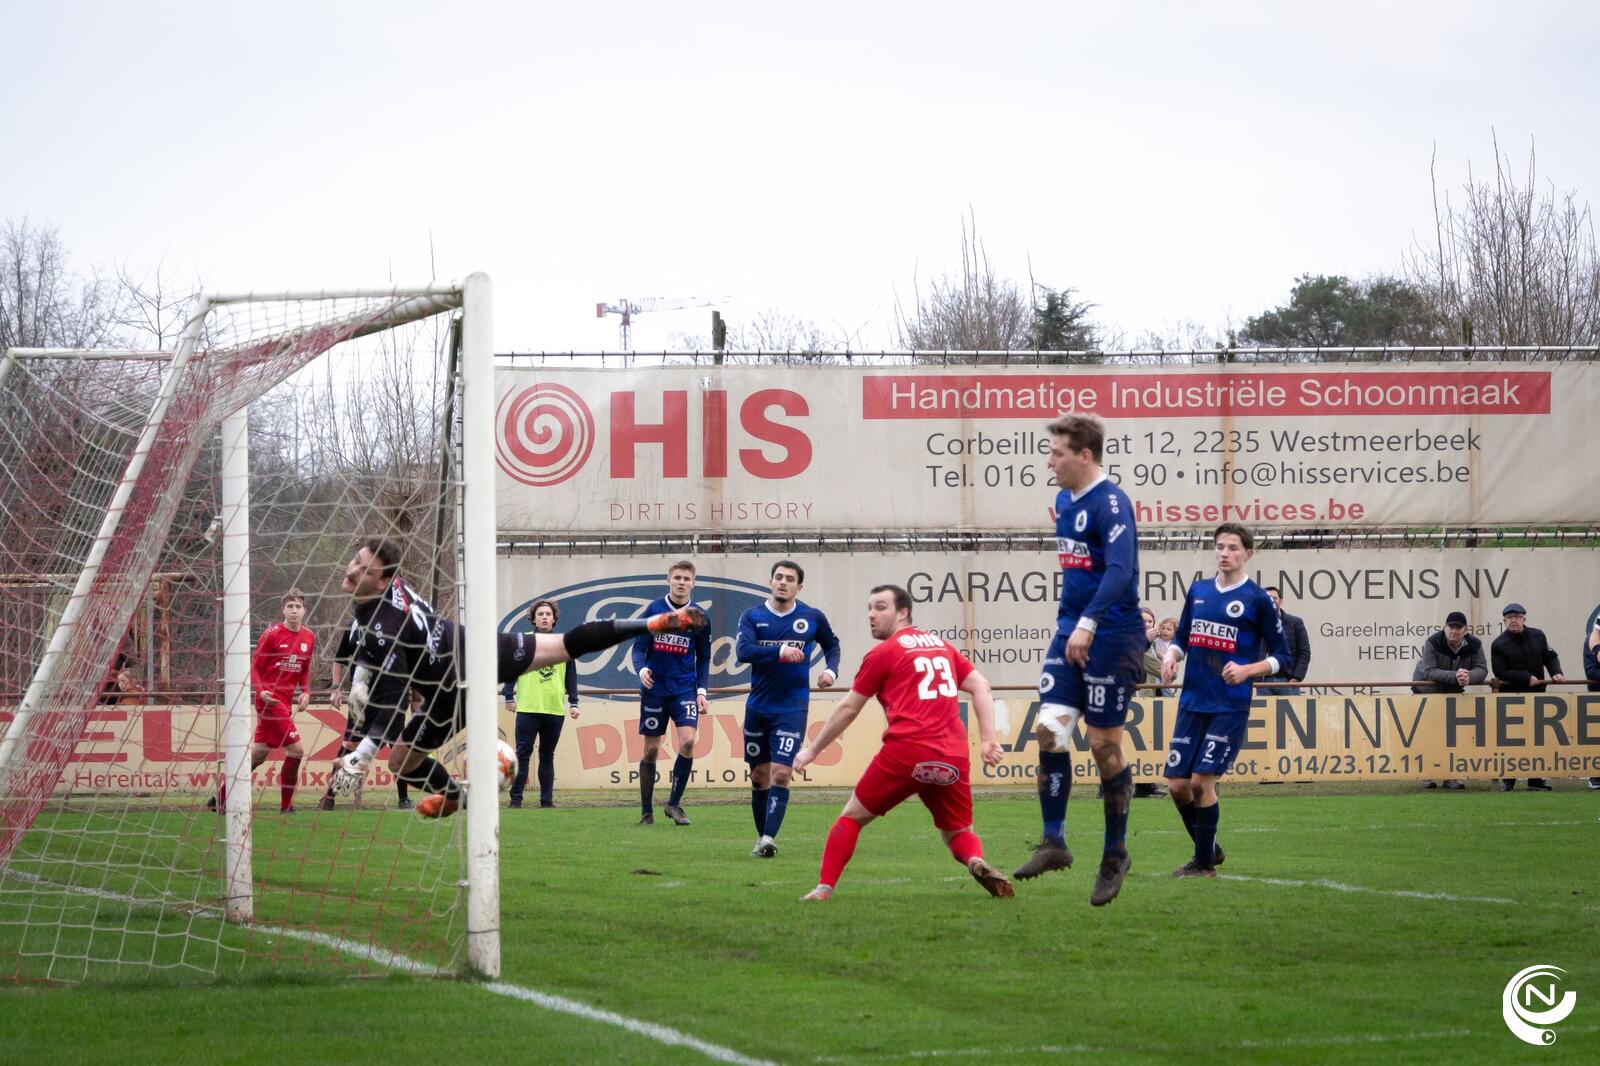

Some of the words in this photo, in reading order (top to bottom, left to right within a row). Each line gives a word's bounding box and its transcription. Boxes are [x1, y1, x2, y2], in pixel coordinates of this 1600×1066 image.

[891, 382, 1097, 415] Handmatige
[1112, 380, 1286, 408] Industriële
[1299, 377, 1520, 407] Schoonmaak
[610, 388, 813, 479] HIS
[1145, 431, 1182, 457] 12,
[1194, 430, 1259, 453] 2235
[1271, 427, 1481, 453] Westmeerbeek
[926, 464, 974, 487] Tel.
[985, 464, 1036, 488] 016
[1133, 463, 1166, 487] 90
[1196, 459, 1470, 487] info@hisservices.be
[610, 503, 664, 521] DIRT
[676, 503, 696, 520] IS
[711, 502, 814, 521] HISTORY
[1279, 568, 1440, 601] NOYENS
[1455, 568, 1509, 599] NV
[914, 656, 958, 700] 23
[1087, 685, 1106, 706] 18
[685, 704, 697, 717] 13
[1344, 697, 1427, 749] NV
[779, 737, 794, 752] 19
[1204, 741, 1216, 758] 2
[1277, 753, 1424, 776] 014/23.12.11
